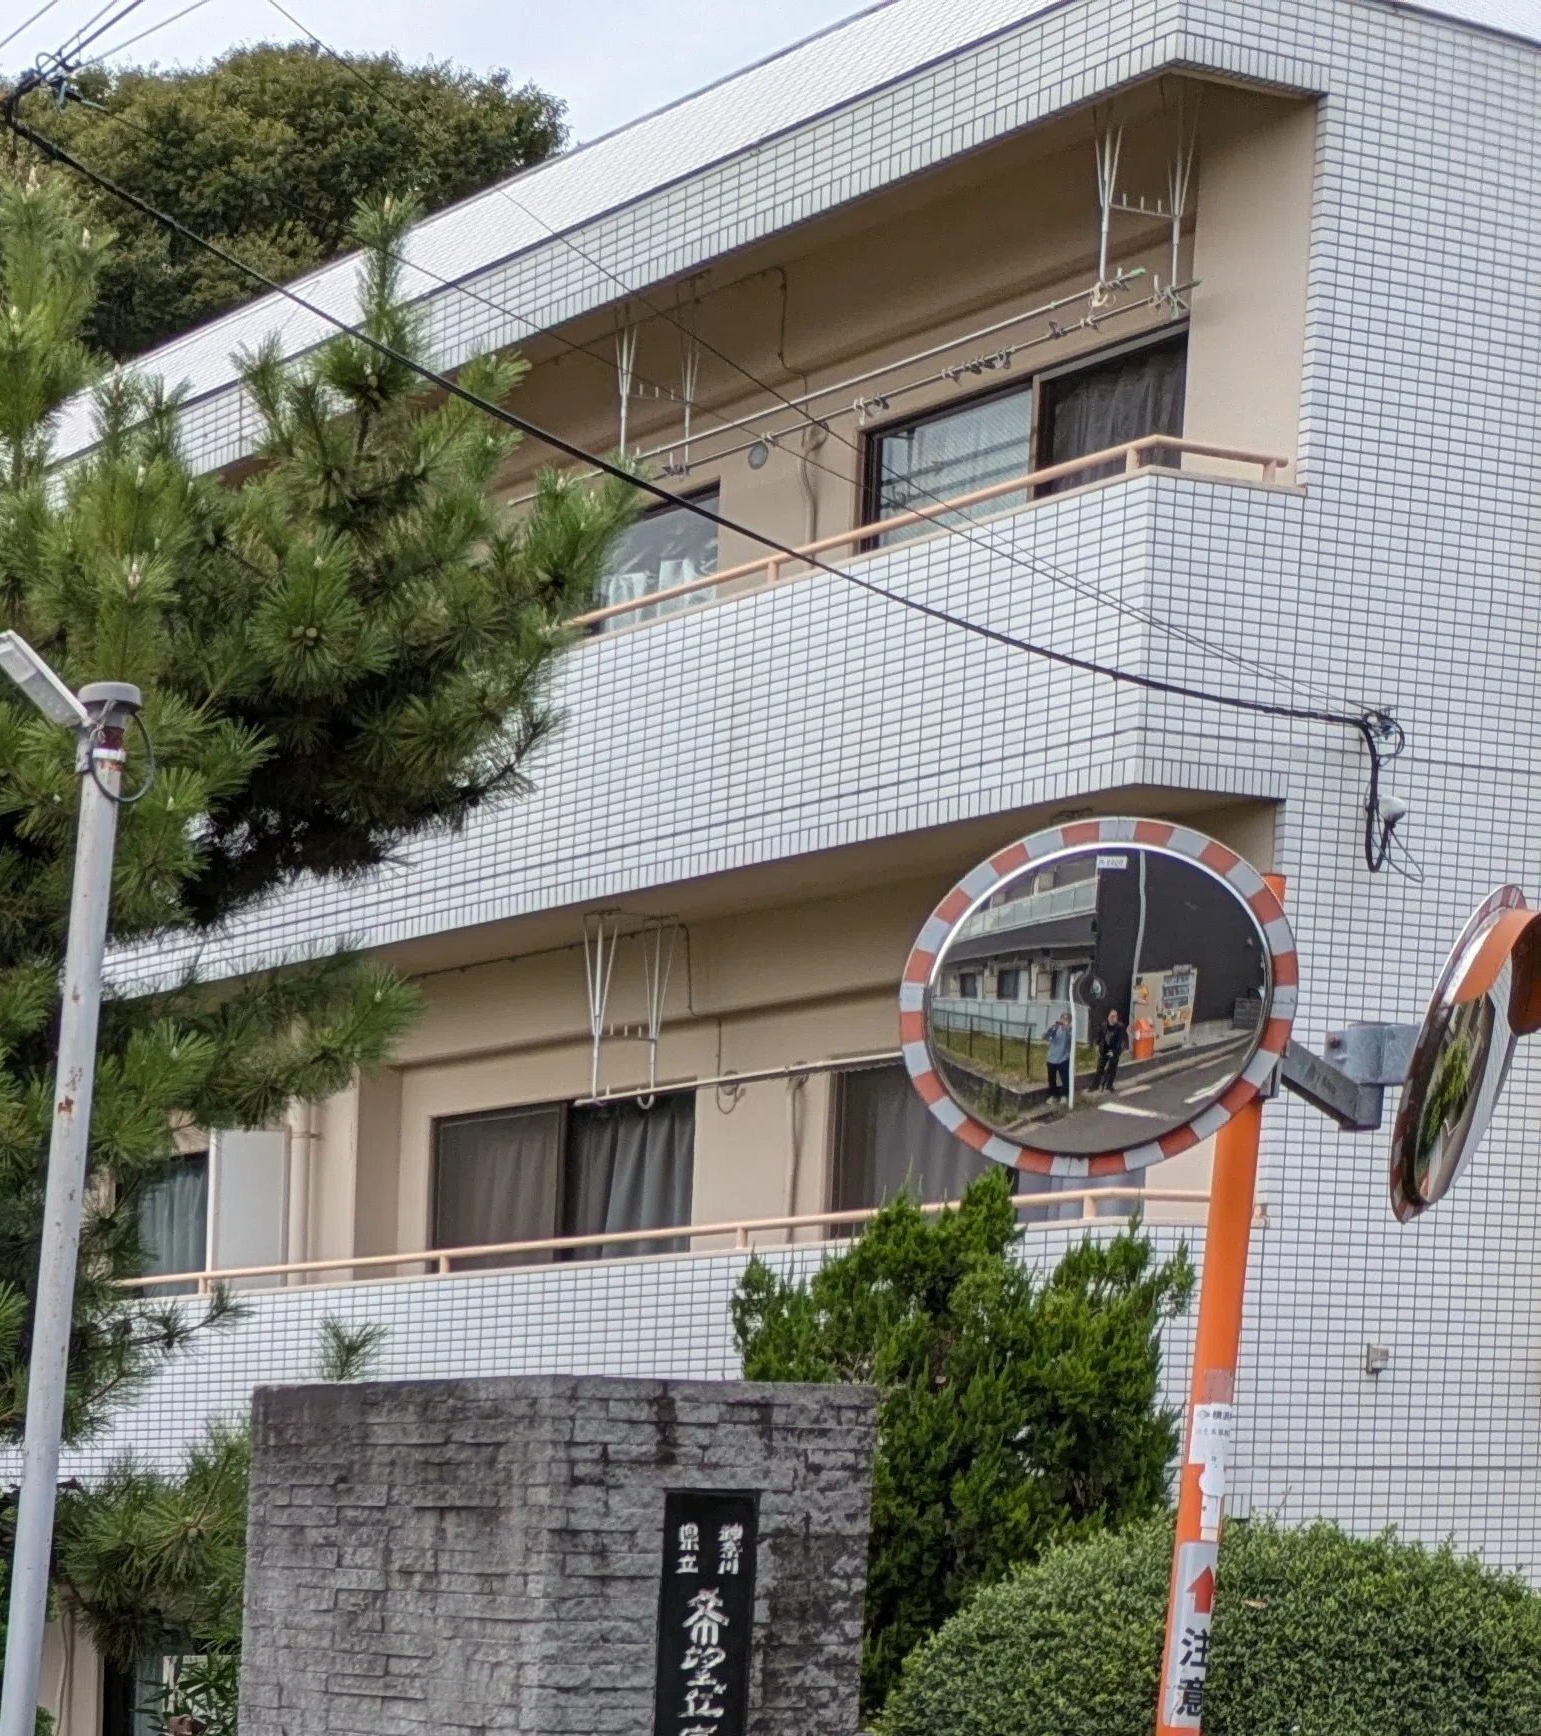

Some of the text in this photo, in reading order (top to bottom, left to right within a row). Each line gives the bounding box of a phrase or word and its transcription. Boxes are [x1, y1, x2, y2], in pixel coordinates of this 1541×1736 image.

[717, 1522, 743, 1574] 神奈川
[1178, 1626, 1211, 1718] 注意
